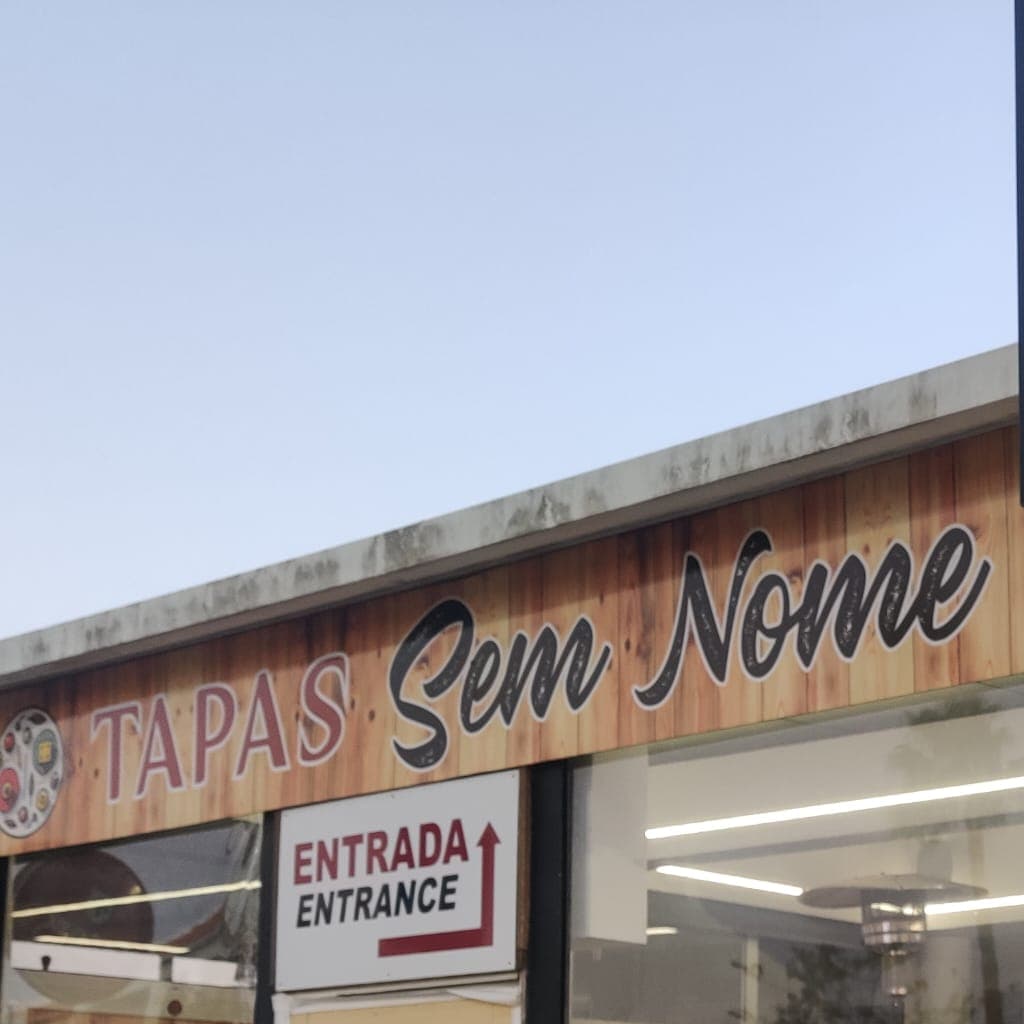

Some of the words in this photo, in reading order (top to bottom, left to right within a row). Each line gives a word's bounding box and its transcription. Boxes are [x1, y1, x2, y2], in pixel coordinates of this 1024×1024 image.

[90, 653, 348, 804] TAPAS
[389, 598, 612, 771] Sem
[633, 524, 991, 709] Nome
[294, 818, 469, 885] ENTRADA
[296, 874, 459, 928] ENTRANCE
